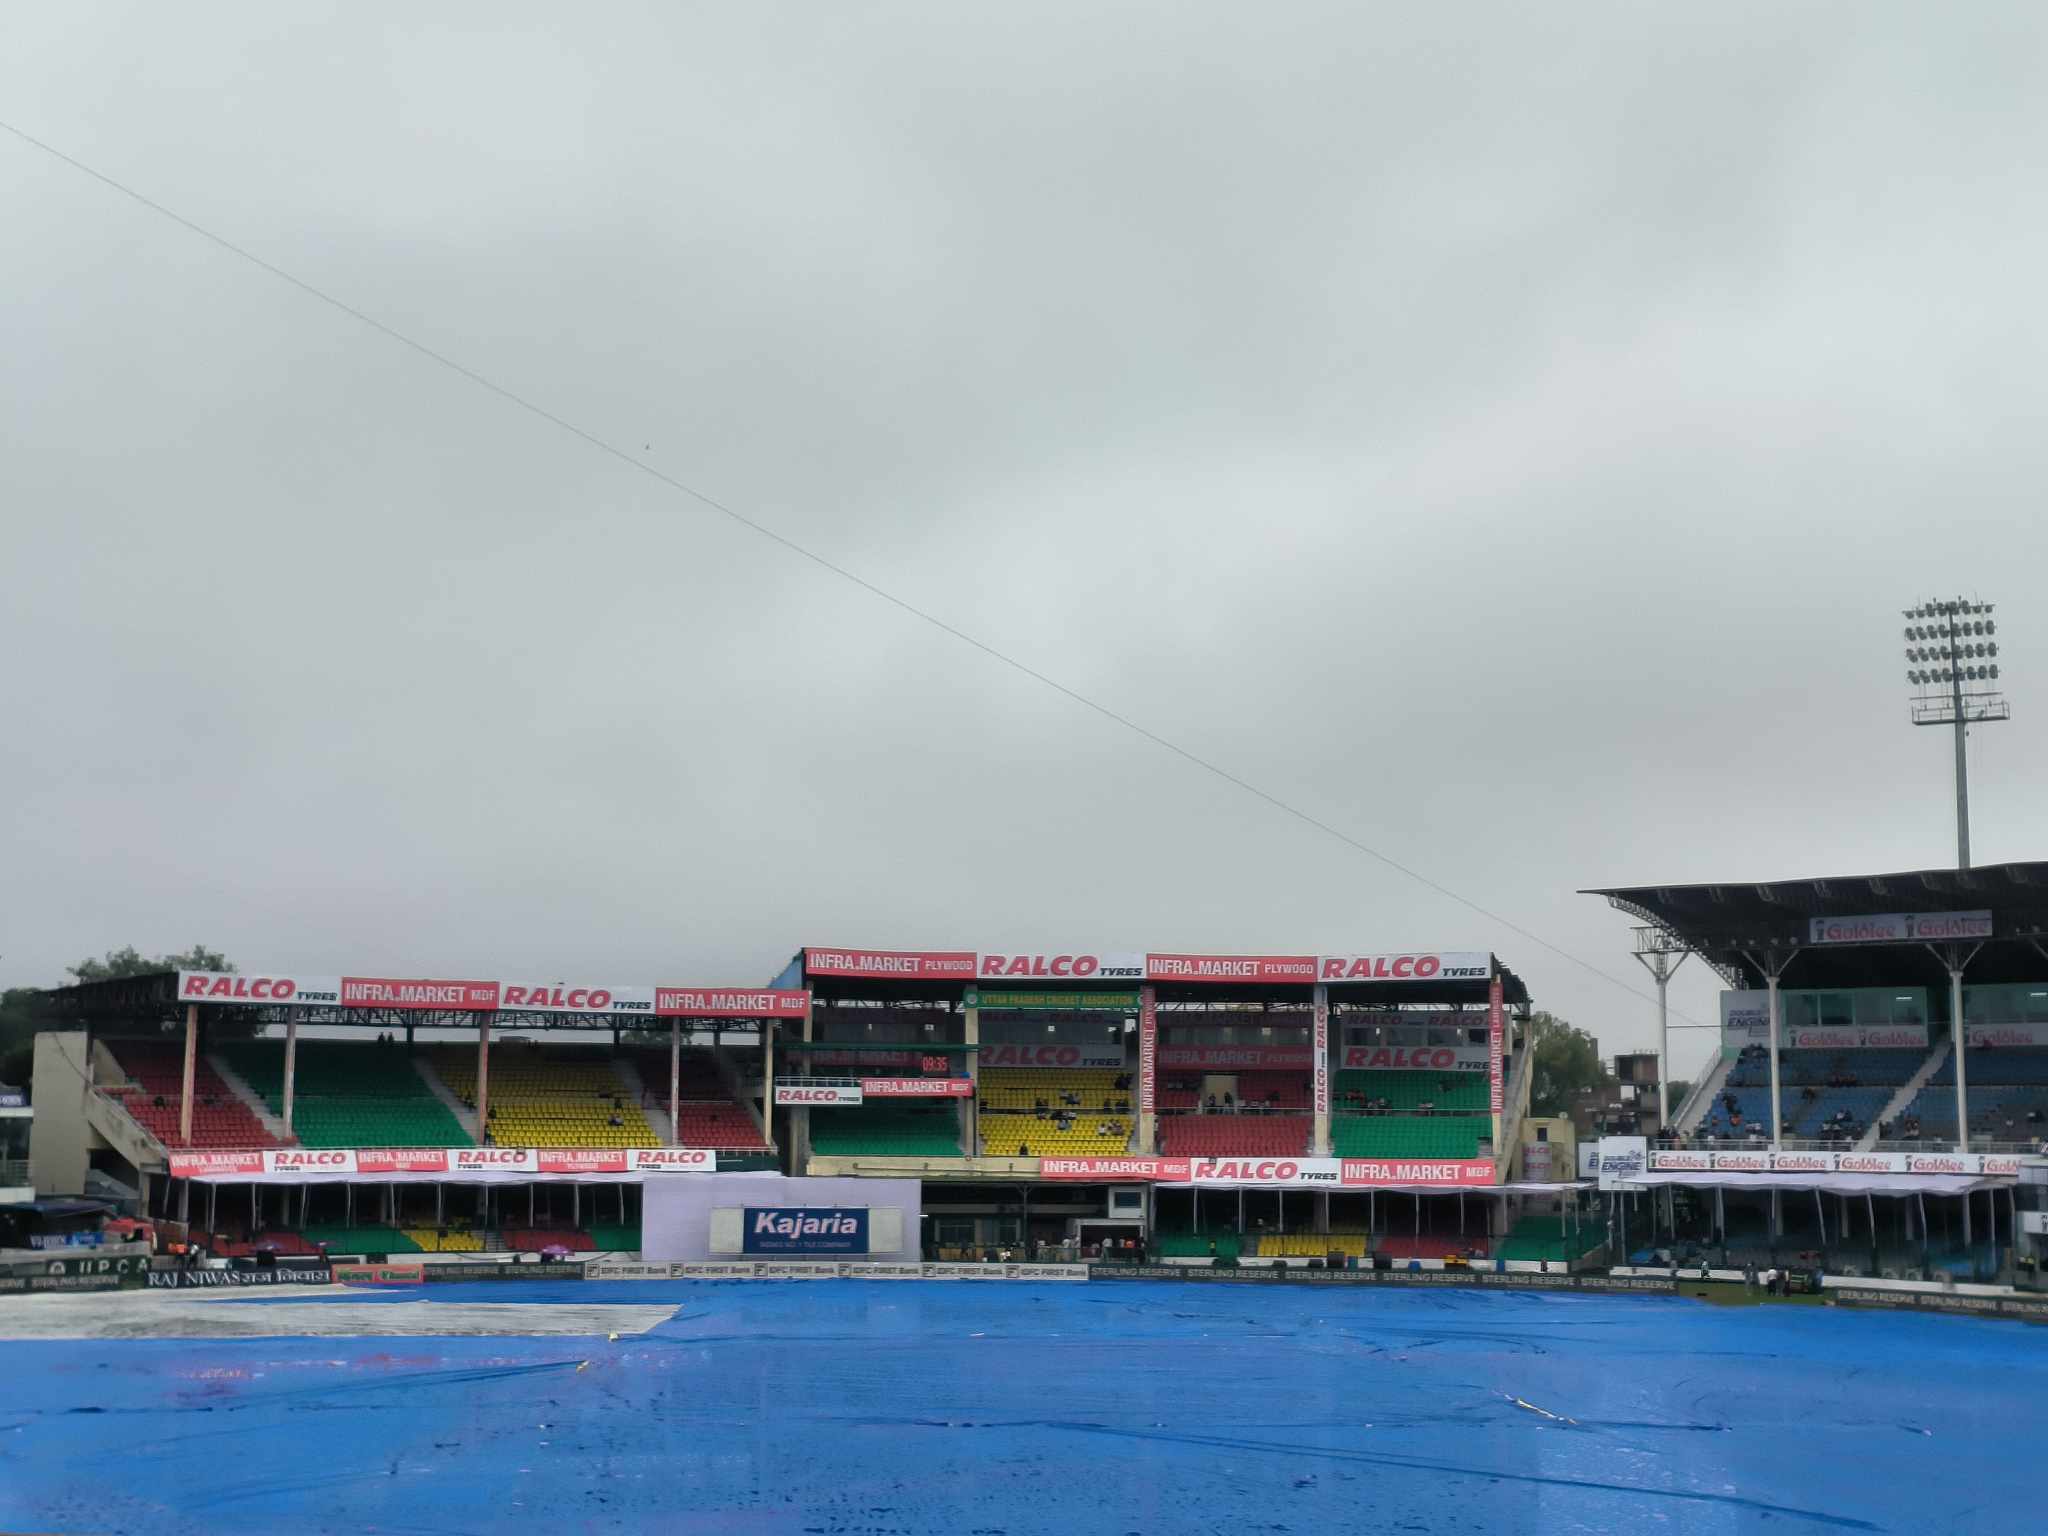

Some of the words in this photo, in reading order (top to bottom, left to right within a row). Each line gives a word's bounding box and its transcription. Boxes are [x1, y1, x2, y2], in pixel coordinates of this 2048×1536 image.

[809, 953, 921, 972] INFRA.MARKET
[925, 960, 974, 971] PLYWOOD
[981, 955, 1098, 976] RALCO
[1100, 967, 1143, 976] TYRES
[1149, 958, 1260, 976] INFRA.MARKET
[1264, 963, 1314, 974] PLYWOOD
[1321, 956, 1440, 978] RALCO
[1443, 967, 1487, 977] TYRES
[184, 975, 296, 998] RALCO
[298, 991, 338, 1001] TYRES
[345, 983, 467, 1003] INFRA.MARKET
[471, 989, 496, 1001] MDF
[504, 986, 612, 1008] RALCO
[613, 1001, 651, 1009] TYRES
[659, 993, 776, 1010] INFRA.MARKET
[781, 997, 805, 1008] MDF
[1317, 1006, 1326, 1049] RALCO
[922, 1056, 949, 1072] 09:35
[1083, 1058, 1121, 1066] TYRES
[1345, 1048, 1457, 1068] RALCO
[1458, 1061, 1490, 1070] TYRE
[778, 1089, 838, 1101] RALCO
[865, 1081, 949, 1093] INFRA.MARKET
[1317, 1068, 1326, 1113] RALCO
[275, 1152, 347, 1165] RALCO
[359, 1150, 445, 1163] INFRA.MARKET
[458, 1151, 528, 1164] RALCO
[540, 1151, 623, 1163] INFRA.MARKET
[637, 1151, 706, 1164] RALCO
[1044, 1160, 1158, 1174] INFRA.MARKET
[1195, 1161, 1298, 1179] RALCO
[1301, 1172, 1338, 1180] TYRES
[1345, 1163, 1461, 1180] INFRA.MARKET
[1466, 1166, 1493, 1177] MDF
[1601, 1161, 1641, 1171] ENGINE
[755, 1207, 858, 1239] Kajaria
[149, 1271, 178, 1289] RAJ
[184, 1269, 240, 1286] NIWAS
[1285, 1271, 1331, 1280] STERLING
[1333, 1271, 1376, 1281] RESERVE
[1383, 1272, 1430, 1281] STERLING
[1432, 1273, 1476, 1283] RESERVE
